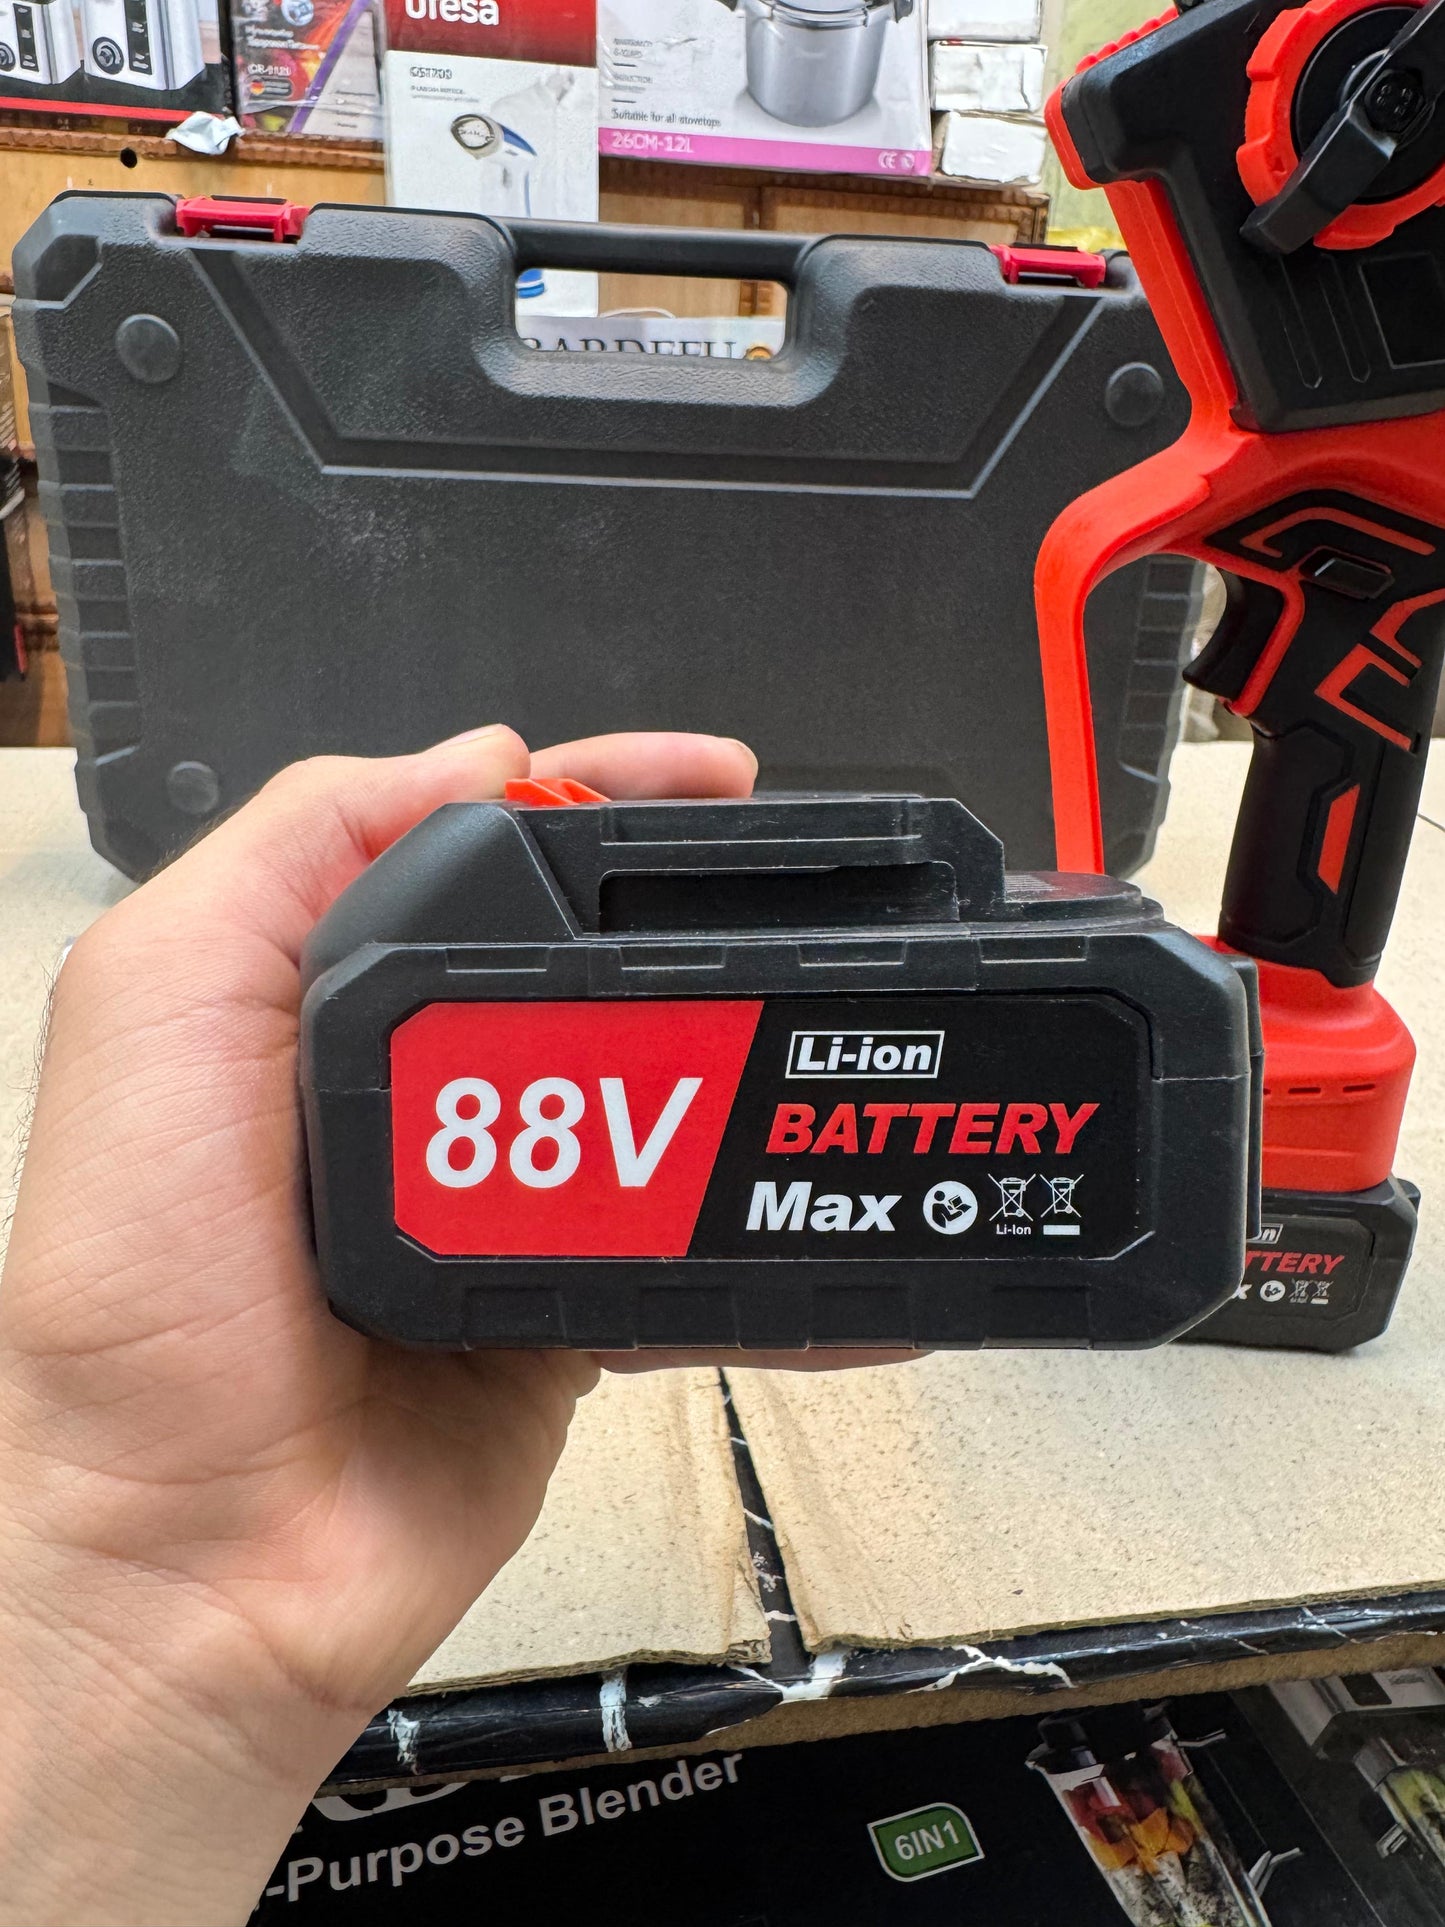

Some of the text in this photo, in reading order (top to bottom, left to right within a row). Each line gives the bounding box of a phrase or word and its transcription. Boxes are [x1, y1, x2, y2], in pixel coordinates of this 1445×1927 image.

[798, 1037, 935, 1072] Li-ion
[426, 1077, 703, 1188] 88V
[766, 1103, 1099, 1154] BATTERY
[746, 1182, 902, 1231] Max
[1244, 1250, 1345, 1275] TTERY
[264, 1815, 525, 1902] -Purpose
[540, 1752, 742, 1837] Blender
[895, 1820, 960, 1860] 6IN1
